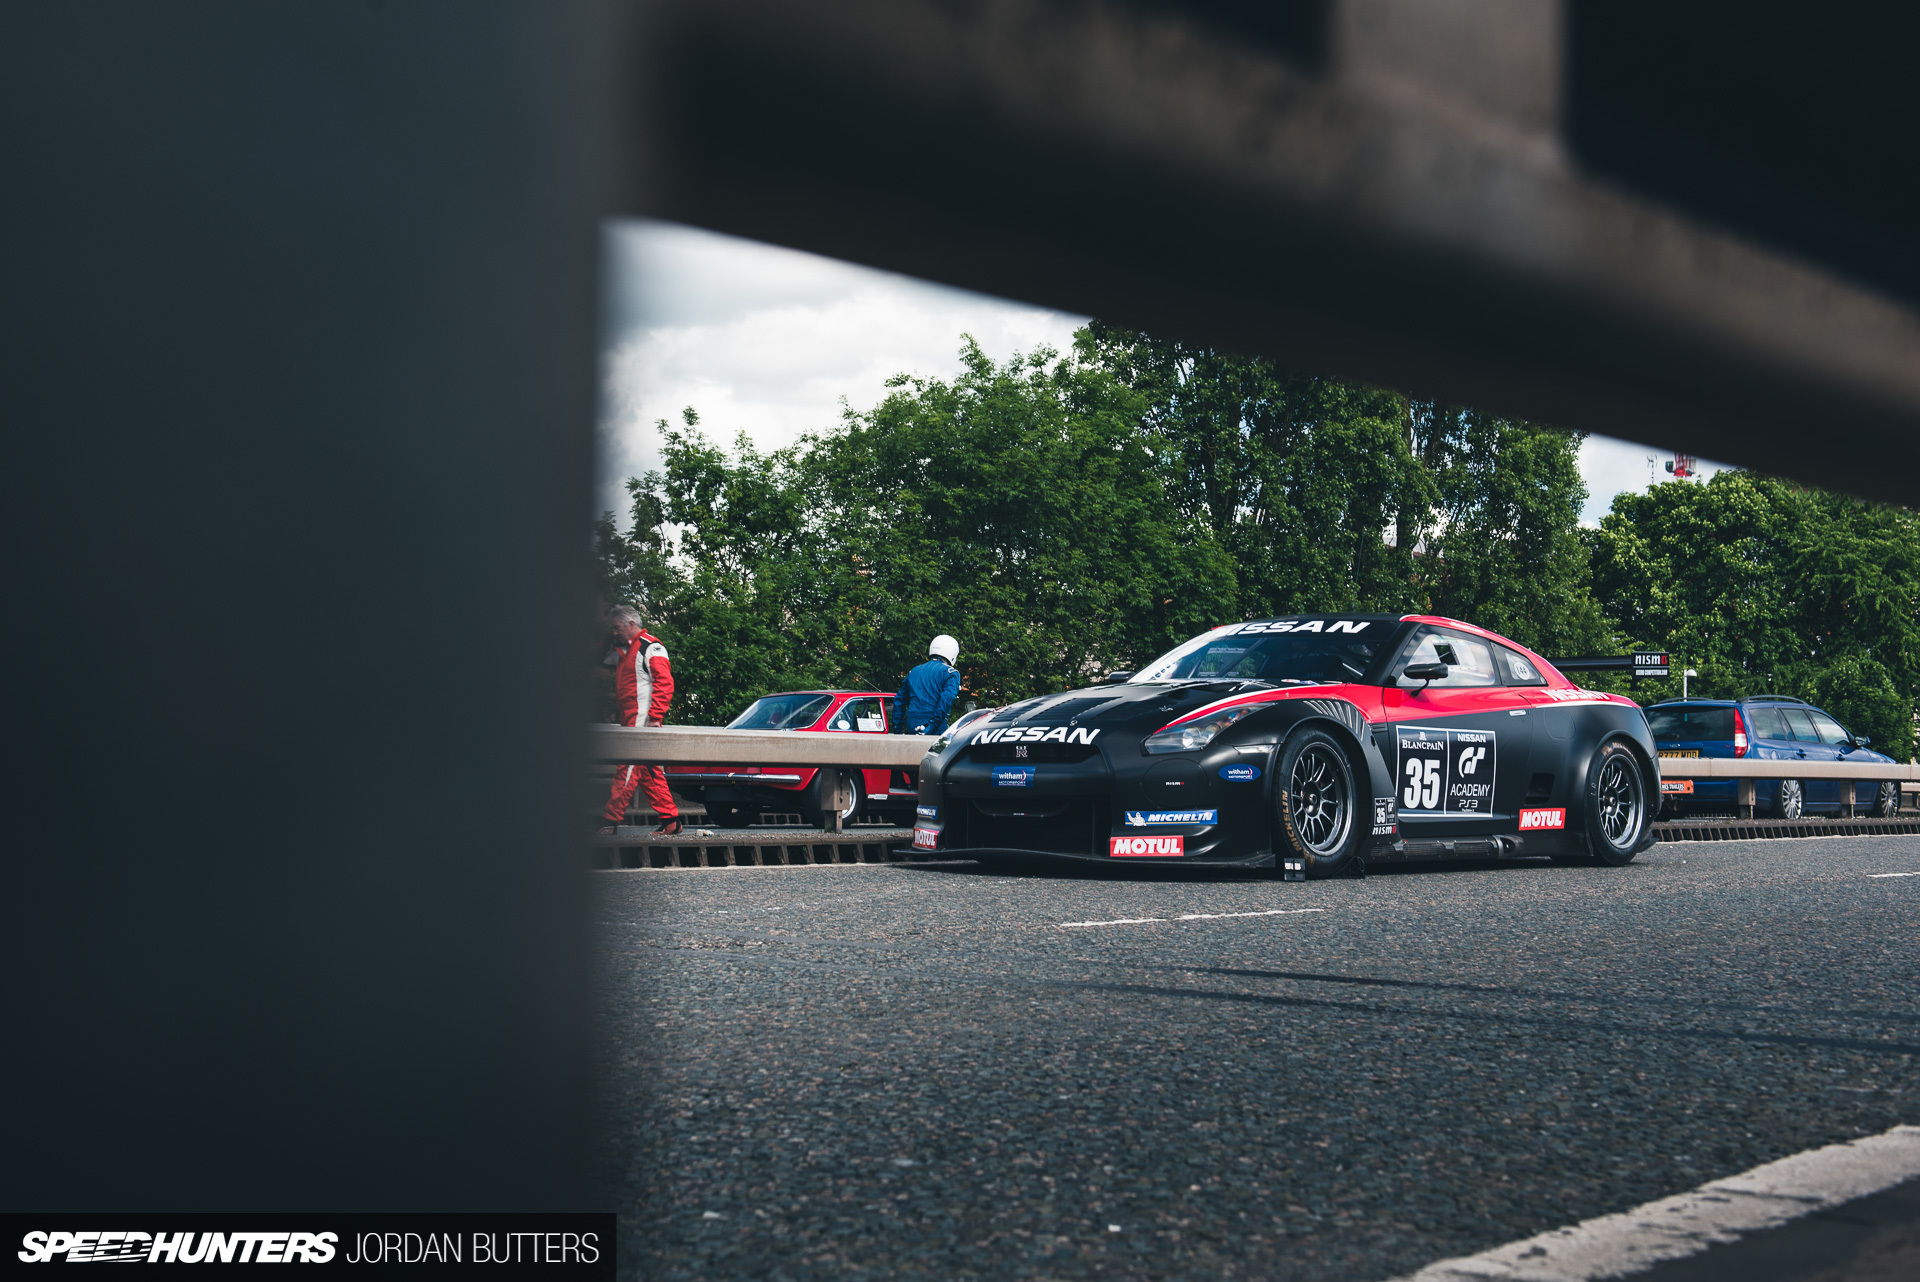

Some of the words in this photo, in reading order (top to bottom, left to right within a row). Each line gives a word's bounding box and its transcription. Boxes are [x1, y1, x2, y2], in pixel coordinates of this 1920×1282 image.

[970, 726, 1100, 745] NISSAN
[1457, 733, 1487, 743] NISSAN
[1401, 739, 1444, 751] BLANCPAIN
[998, 772, 1023, 780] witham
[1403, 757, 1440, 809] 35
[1450, 783, 1490, 797] ACADEMY
[1458, 799, 1478, 808] PS3
[1148, 811, 1214, 822] MICHELIN
[1281, 789, 1303, 852] MICHELIN
[1520, 810, 1563, 828] MOTUL
[914, 830, 936, 846] MOTUL
[1113, 838, 1181, 855] MOTUL
